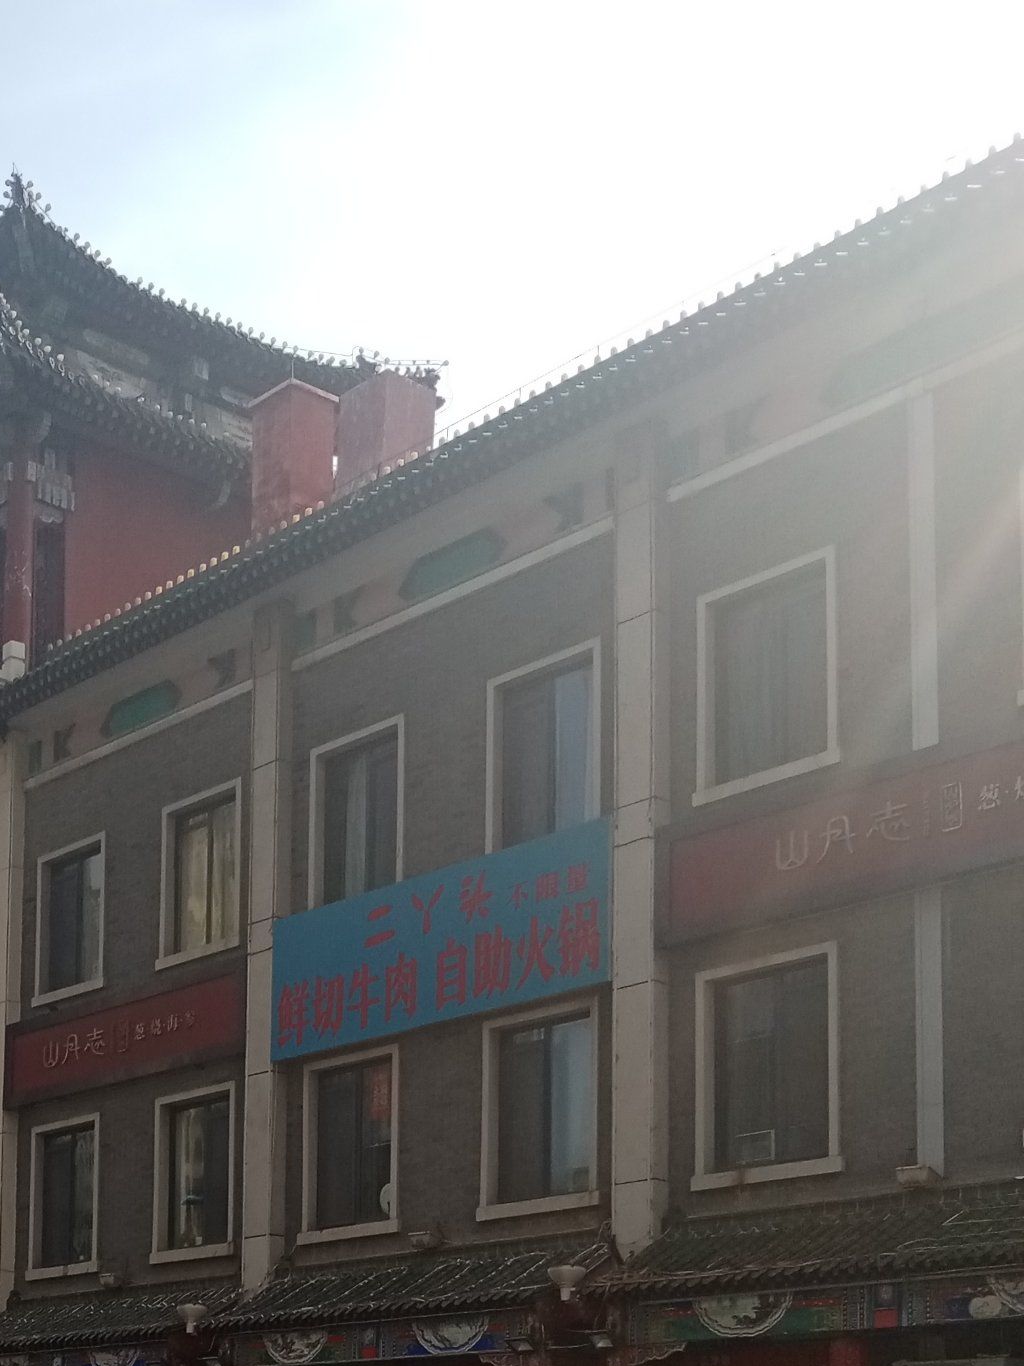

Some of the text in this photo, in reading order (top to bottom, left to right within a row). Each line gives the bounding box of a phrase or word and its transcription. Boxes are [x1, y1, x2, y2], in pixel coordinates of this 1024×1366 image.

[364, 862, 592, 949] 二丫头 不限量
[277, 897, 602, 1048] 鲜切牛肉 自助火锅
